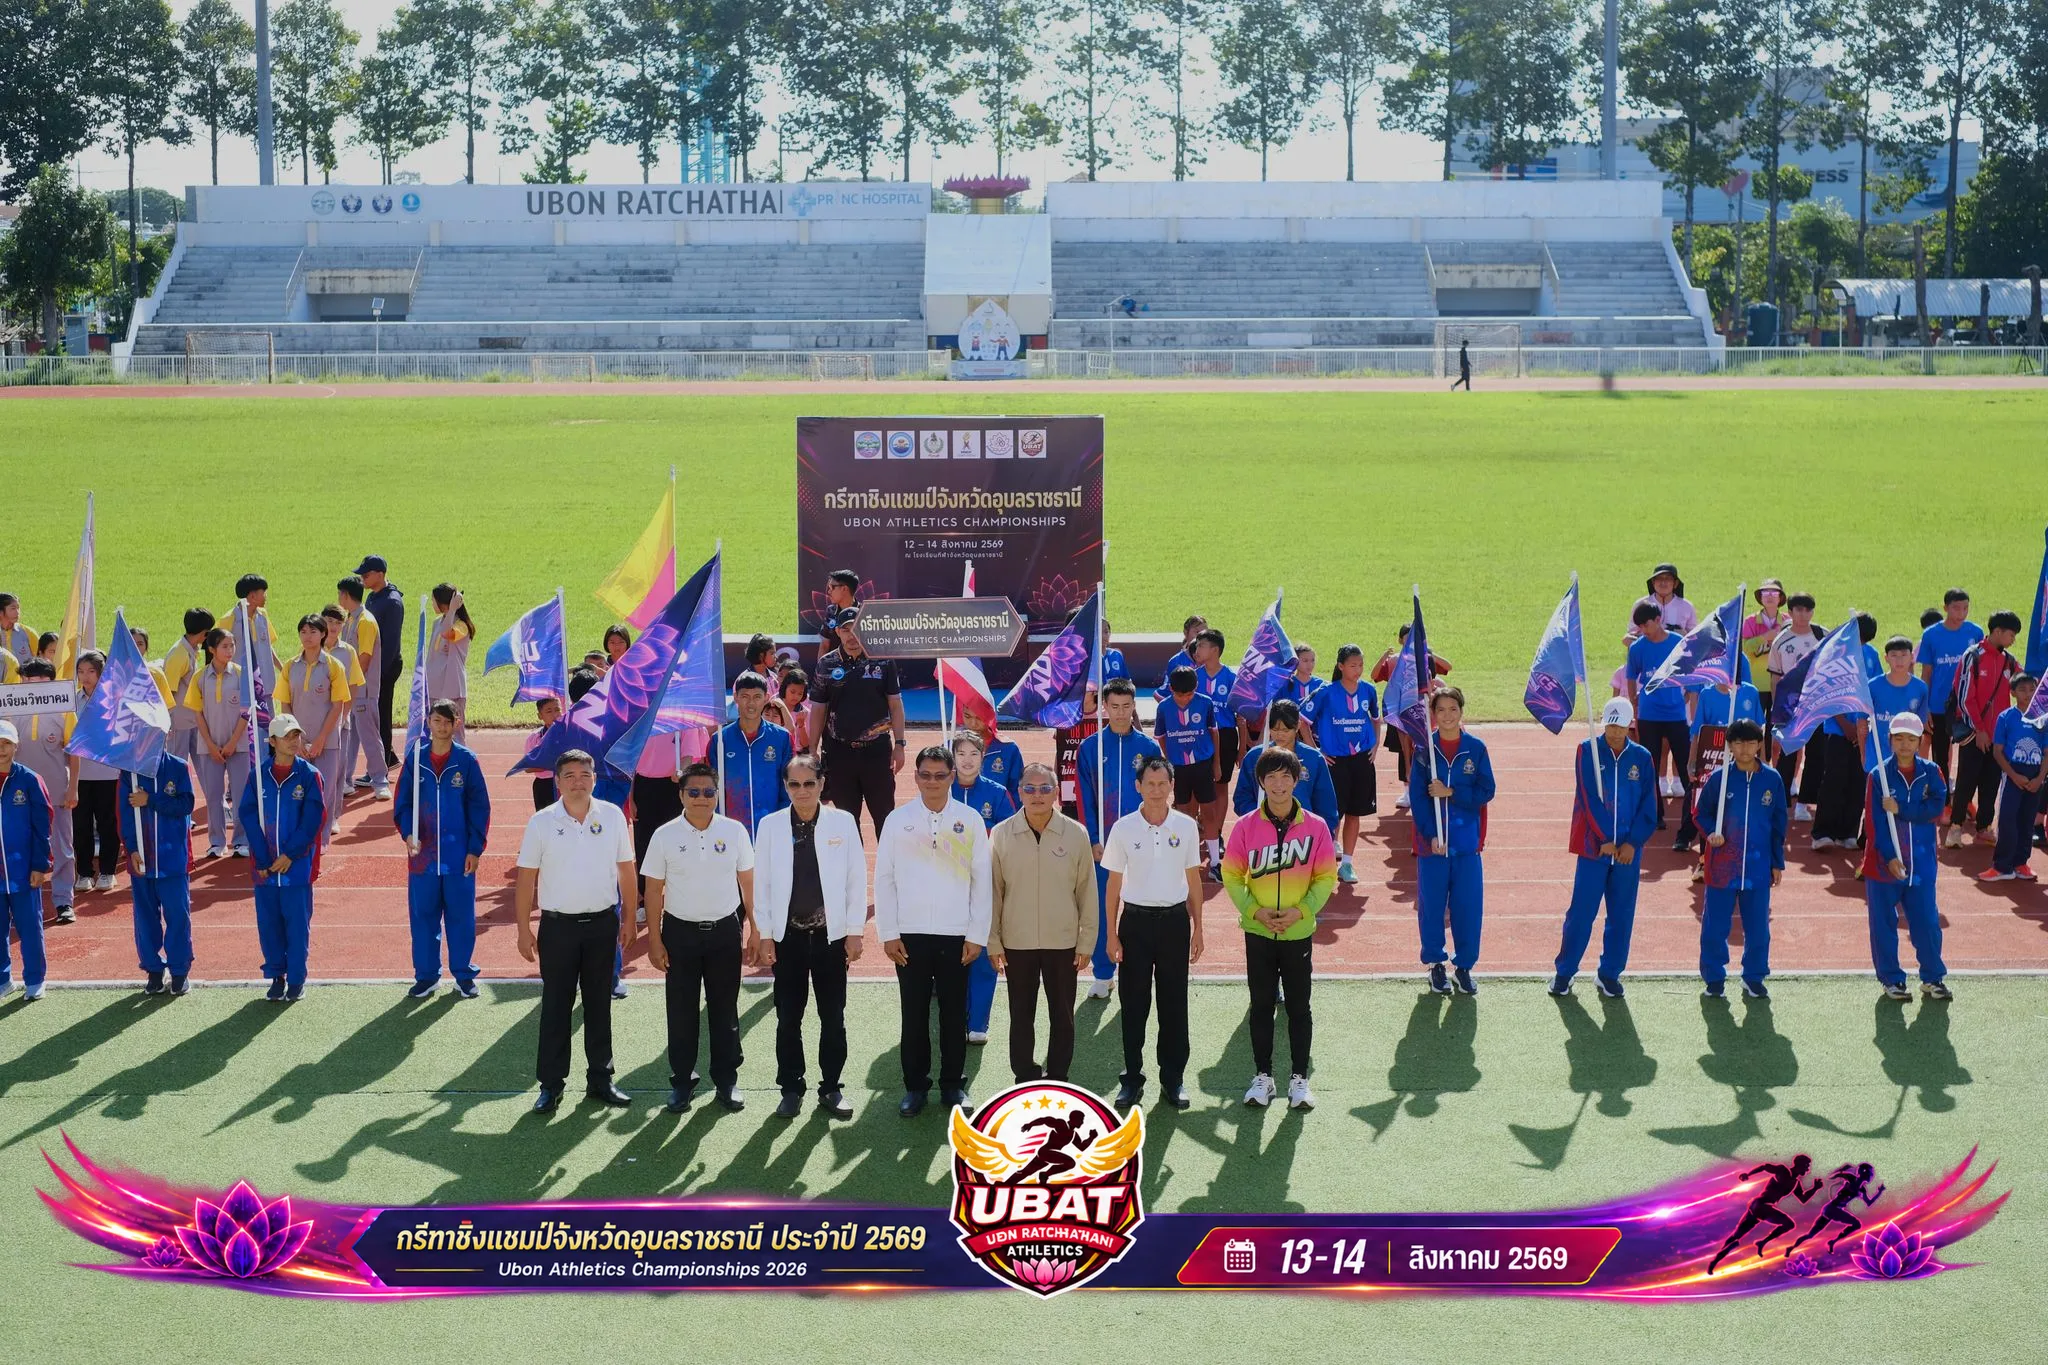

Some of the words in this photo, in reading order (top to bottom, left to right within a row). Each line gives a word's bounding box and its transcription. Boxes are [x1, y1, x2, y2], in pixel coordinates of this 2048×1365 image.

[526, 190, 605, 215] UBON
[817, 192, 859, 205] PRNC
[862, 193, 924, 205] HOSPITAL
[843, 517, 881, 527] UBON
[886, 517, 958, 527] ATHLETICS
[963, 516, 1067, 527] CHAMPIONSHIPS
[904, 540, 915, 549] 12
[927, 540, 938, 549] 14
[941, 539, 978, 549] สิงหาคม
[981, 540, 1004, 549] 2569
[867, 637, 891, 645] UBON
[893, 636, 939, 645] ATHLETICS
[941, 634, 1007, 644] CHAMPIONSHIPS
[1249, 835, 1312, 879] UBN
